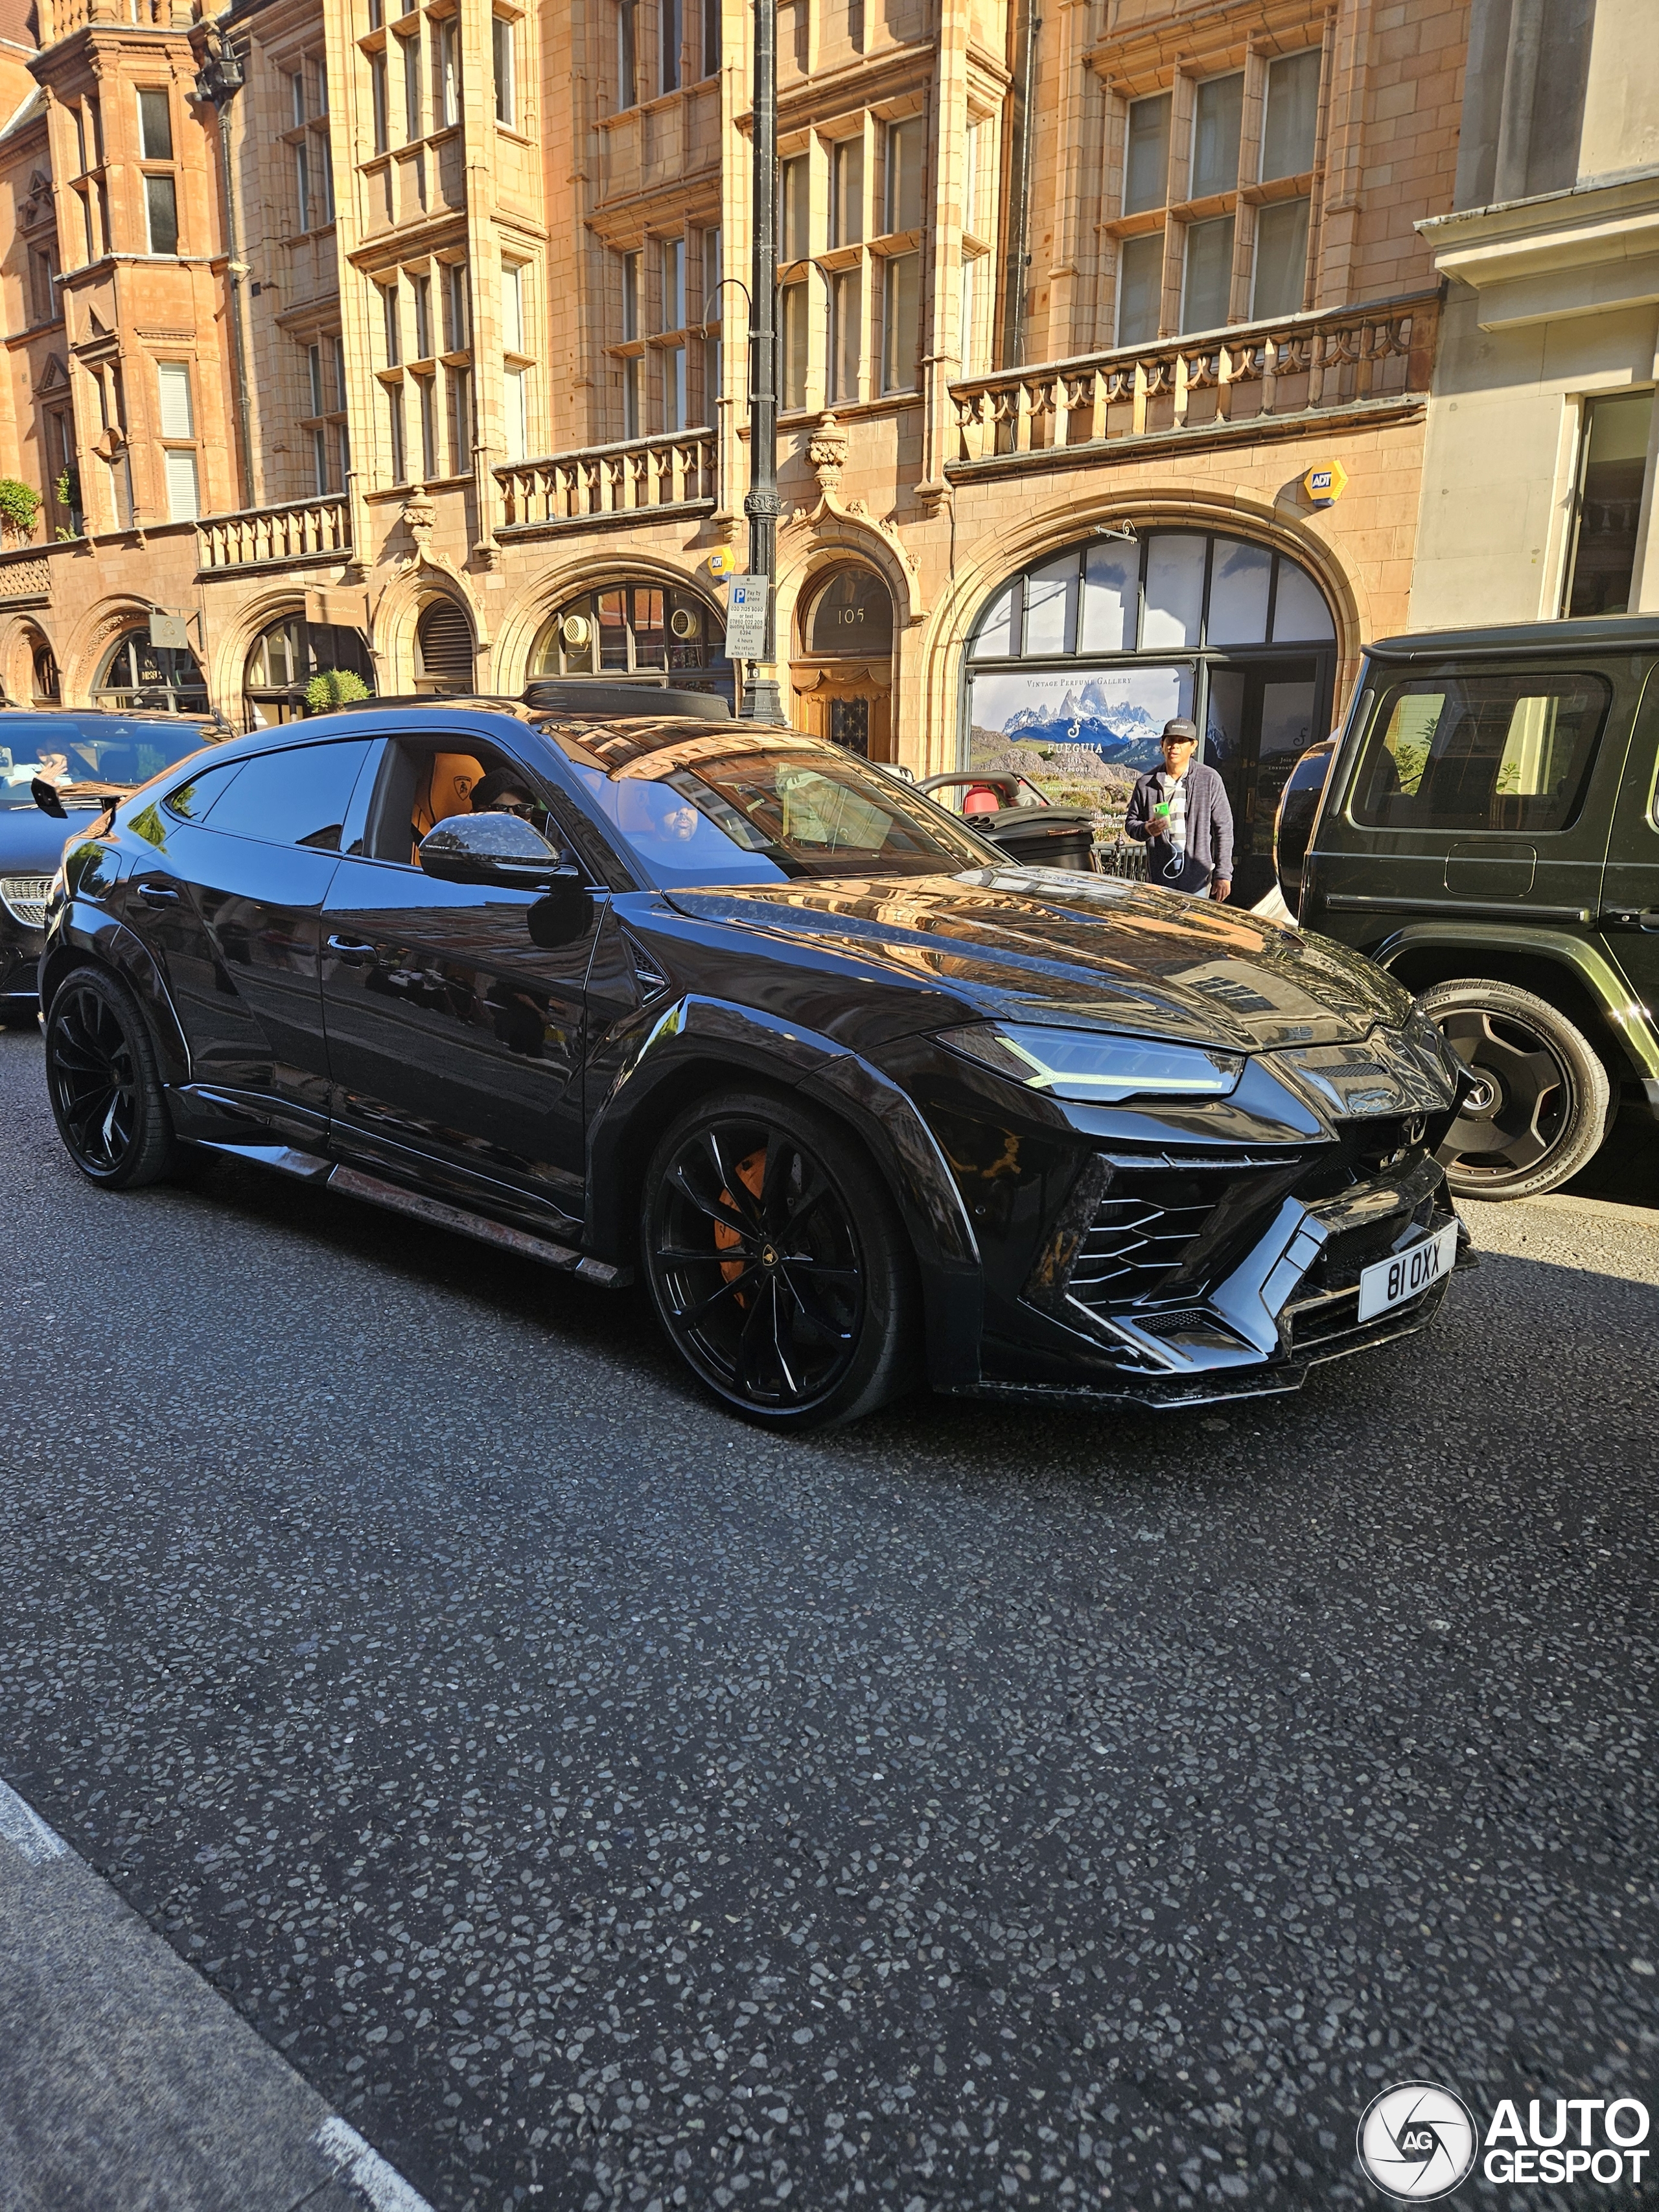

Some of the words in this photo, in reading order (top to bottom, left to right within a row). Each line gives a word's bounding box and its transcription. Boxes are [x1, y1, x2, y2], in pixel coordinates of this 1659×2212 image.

[1312, 473, 1332, 488] ADT
[712, 557, 723, 566] ADT
[736, 589, 745, 603] P
[839, 608, 864, 623] 105
[1047, 743, 1104, 754] FUEGUIA
[1387, 1259, 1406, 1301] 81
[1410, 1237, 1442, 1290] OXX
